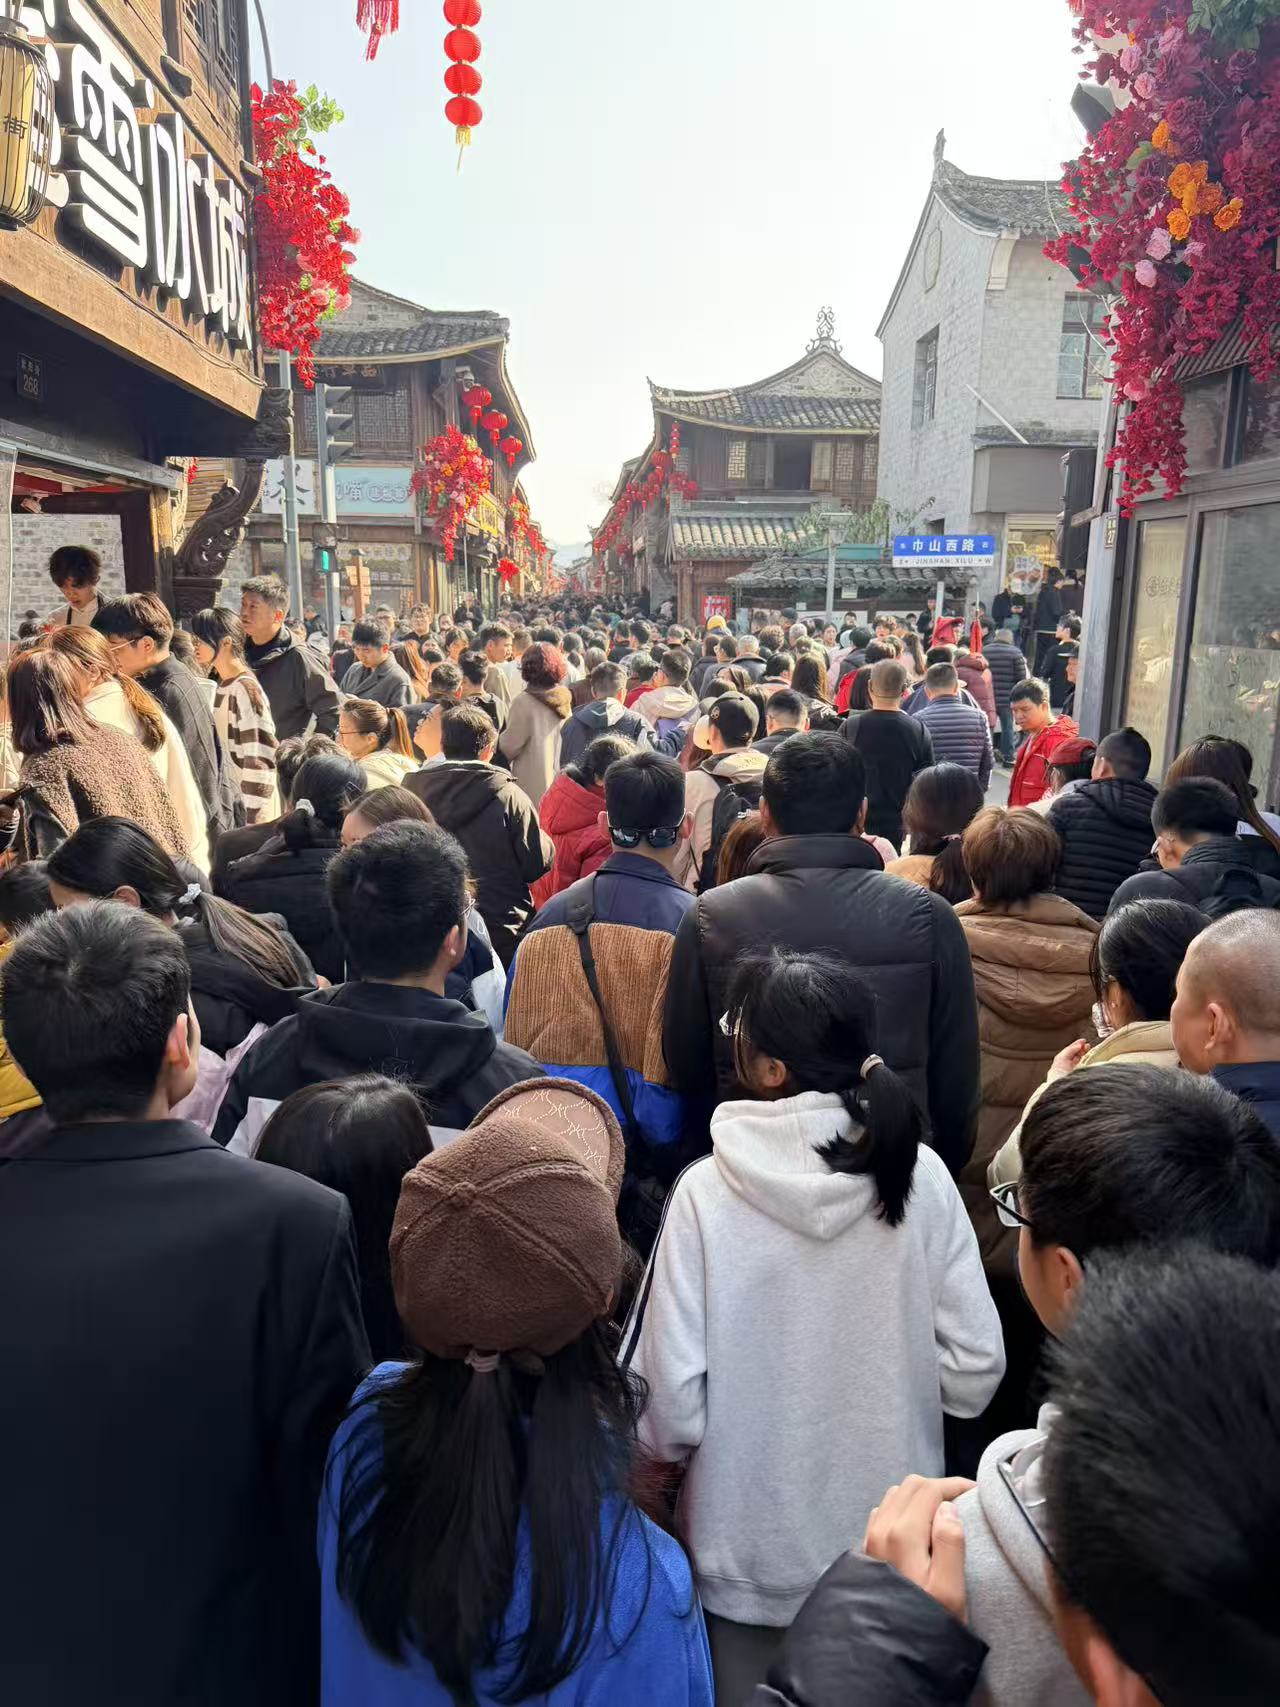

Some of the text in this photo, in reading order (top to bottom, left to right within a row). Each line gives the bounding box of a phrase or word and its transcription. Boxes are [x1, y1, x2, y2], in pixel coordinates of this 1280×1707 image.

[18, 0, 253, 350] 雪冰城
[913, 539, 974, 552] 巾山西路
